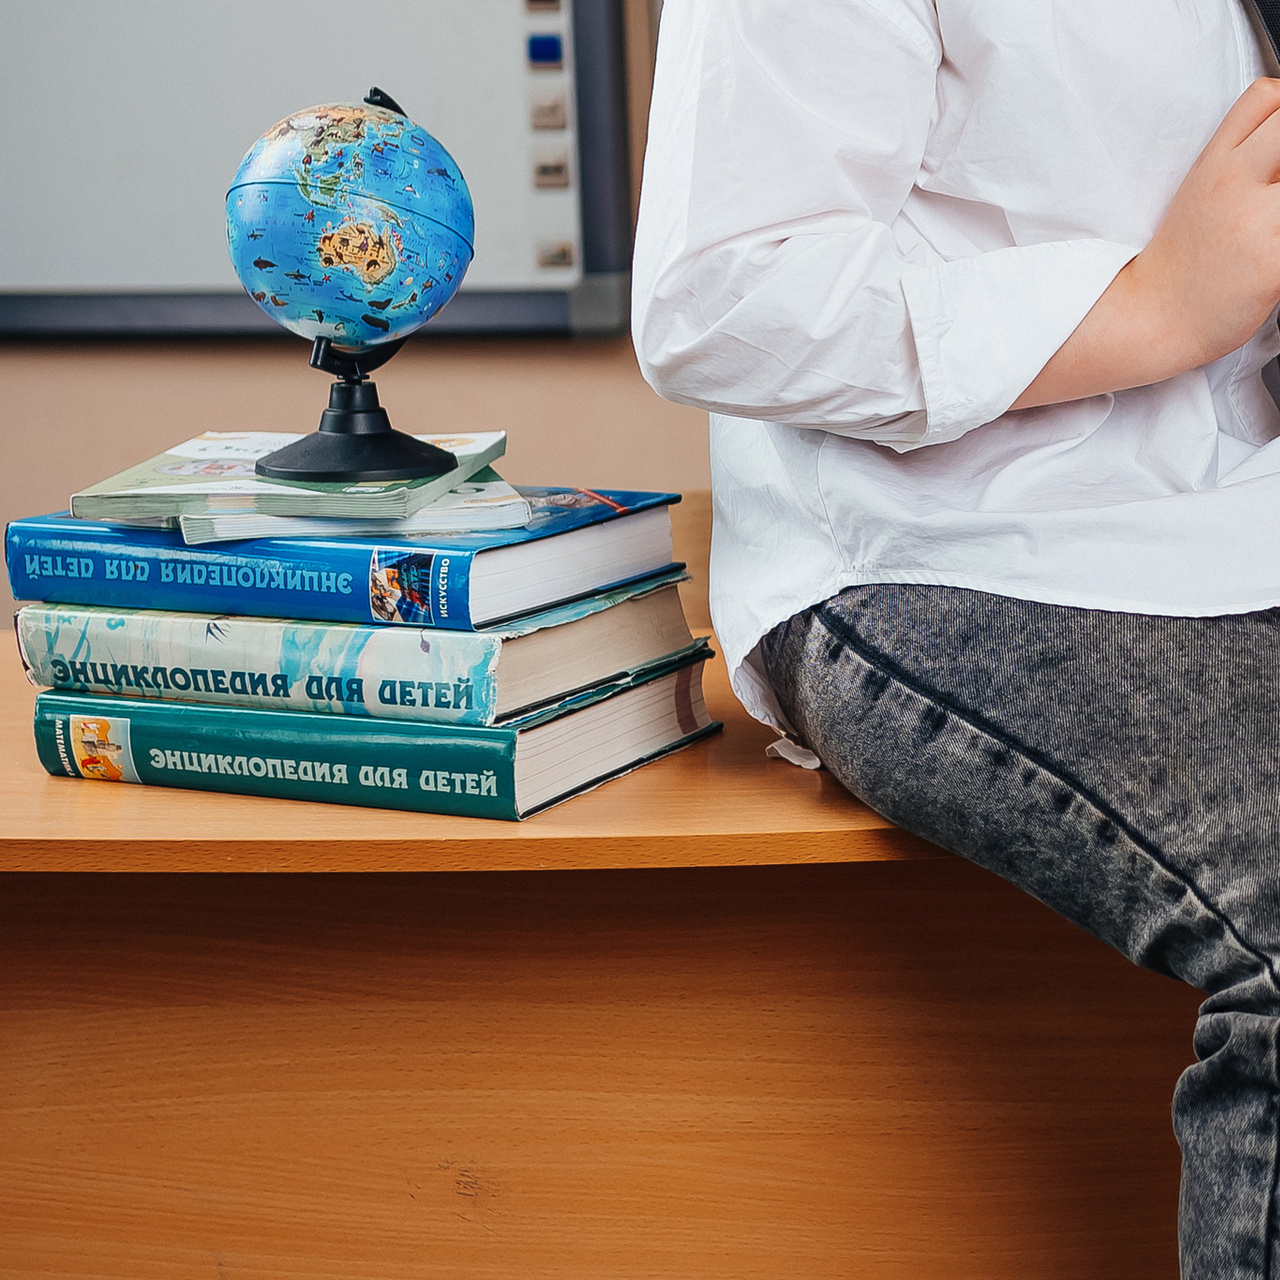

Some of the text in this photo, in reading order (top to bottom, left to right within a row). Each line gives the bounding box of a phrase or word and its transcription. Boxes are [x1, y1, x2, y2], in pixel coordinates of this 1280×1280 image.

[23, 554, 354, 595] ЭНЦИКЛОПЕДИЯ ДЛЯ ДЕТЕЙ
[438, 557, 451, 618] ИСКУССТВО
[50, 658, 475, 711] ЭНЦИКЛОПЕДИЯ ДЛЯ ДЕТЕЙ
[149, 747, 499, 797] ЭНЦИКЛОПЕДИЯ ДЛЯ ДЕТЕЙ
